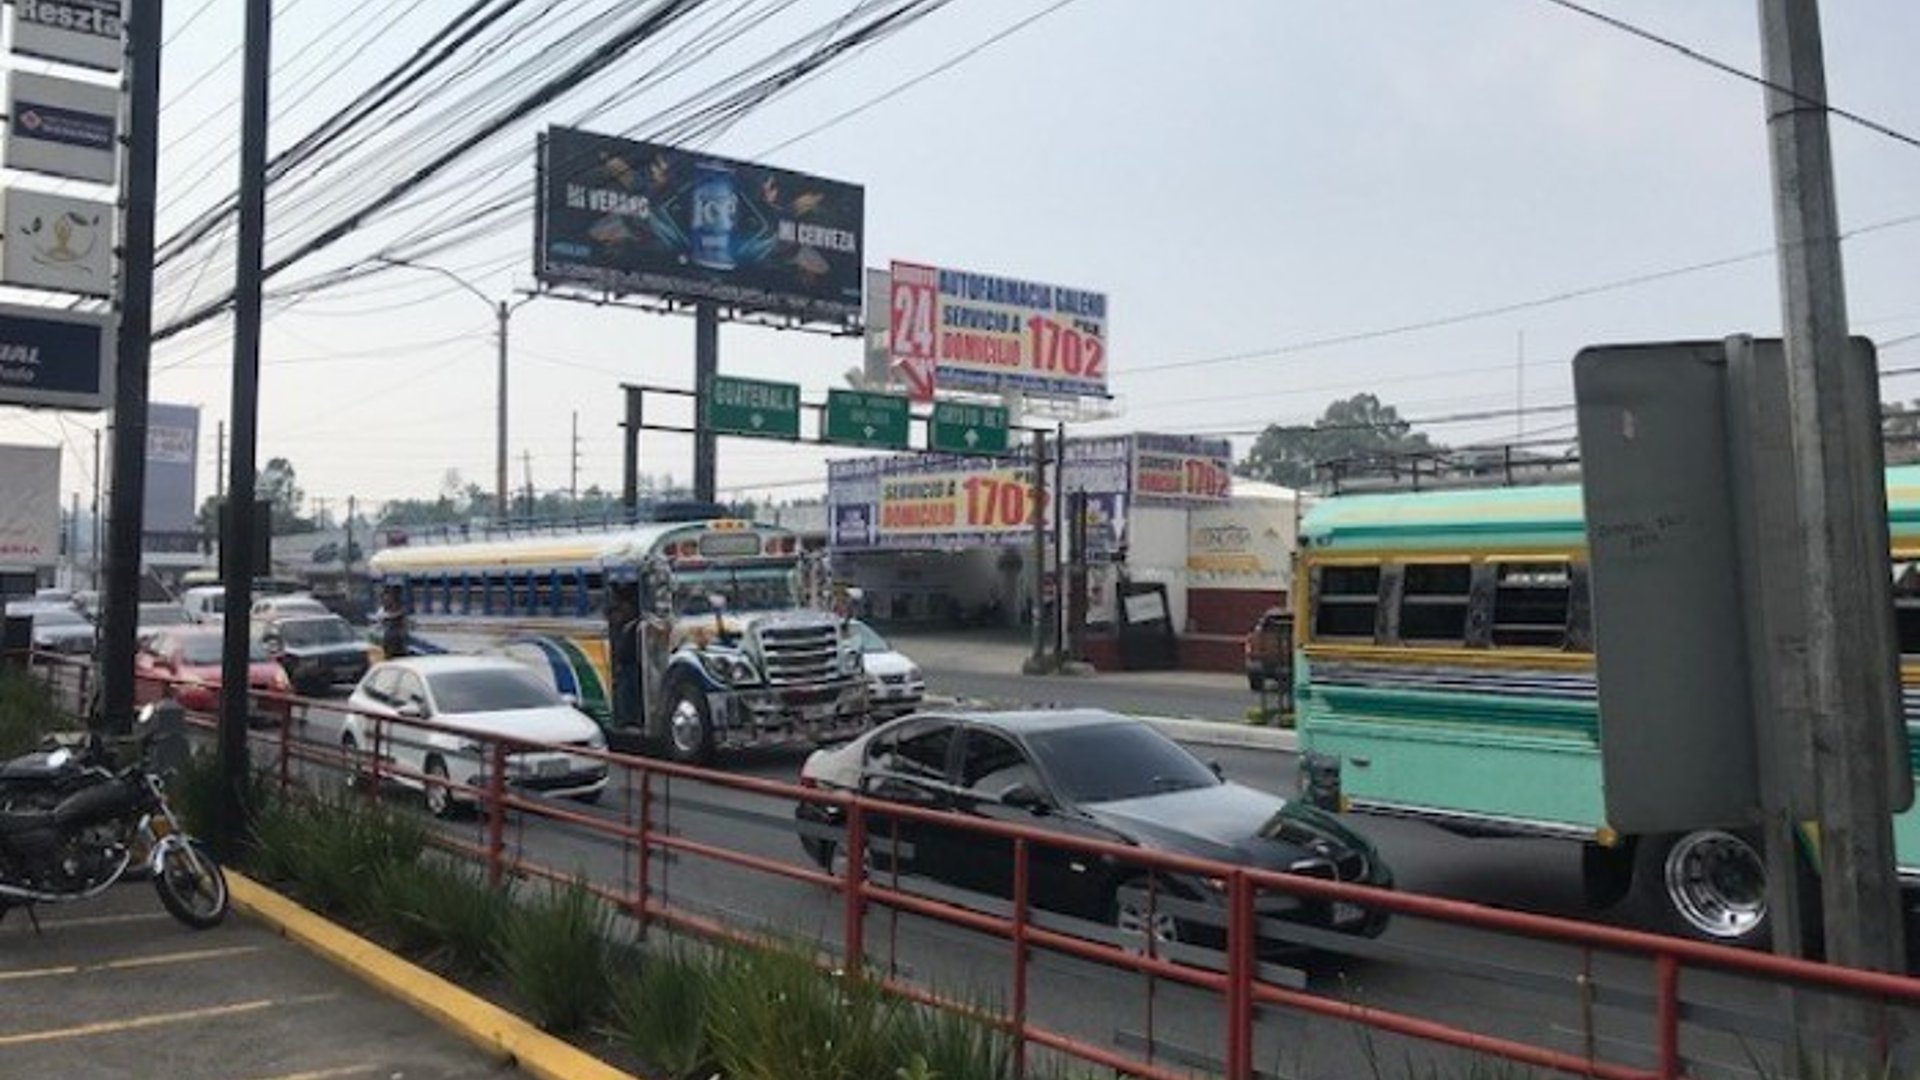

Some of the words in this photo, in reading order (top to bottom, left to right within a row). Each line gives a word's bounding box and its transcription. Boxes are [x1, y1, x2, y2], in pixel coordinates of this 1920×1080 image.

[566, 182, 586, 209] MI
[588, 187, 649, 219] VERANO
[798, 222, 857, 252] CERVEZA
[939, 270, 1051, 309] AUTOFARMACIA
[894, 285, 934, 356] 24
[943, 304, 1008, 333] SERVICIO
[1011, 314, 1021, 334] A
[943, 332, 1020, 367] DOMICILIO
[1027, 315, 1105, 378] 1702
[715, 380, 795, 411] GUATEMALA
